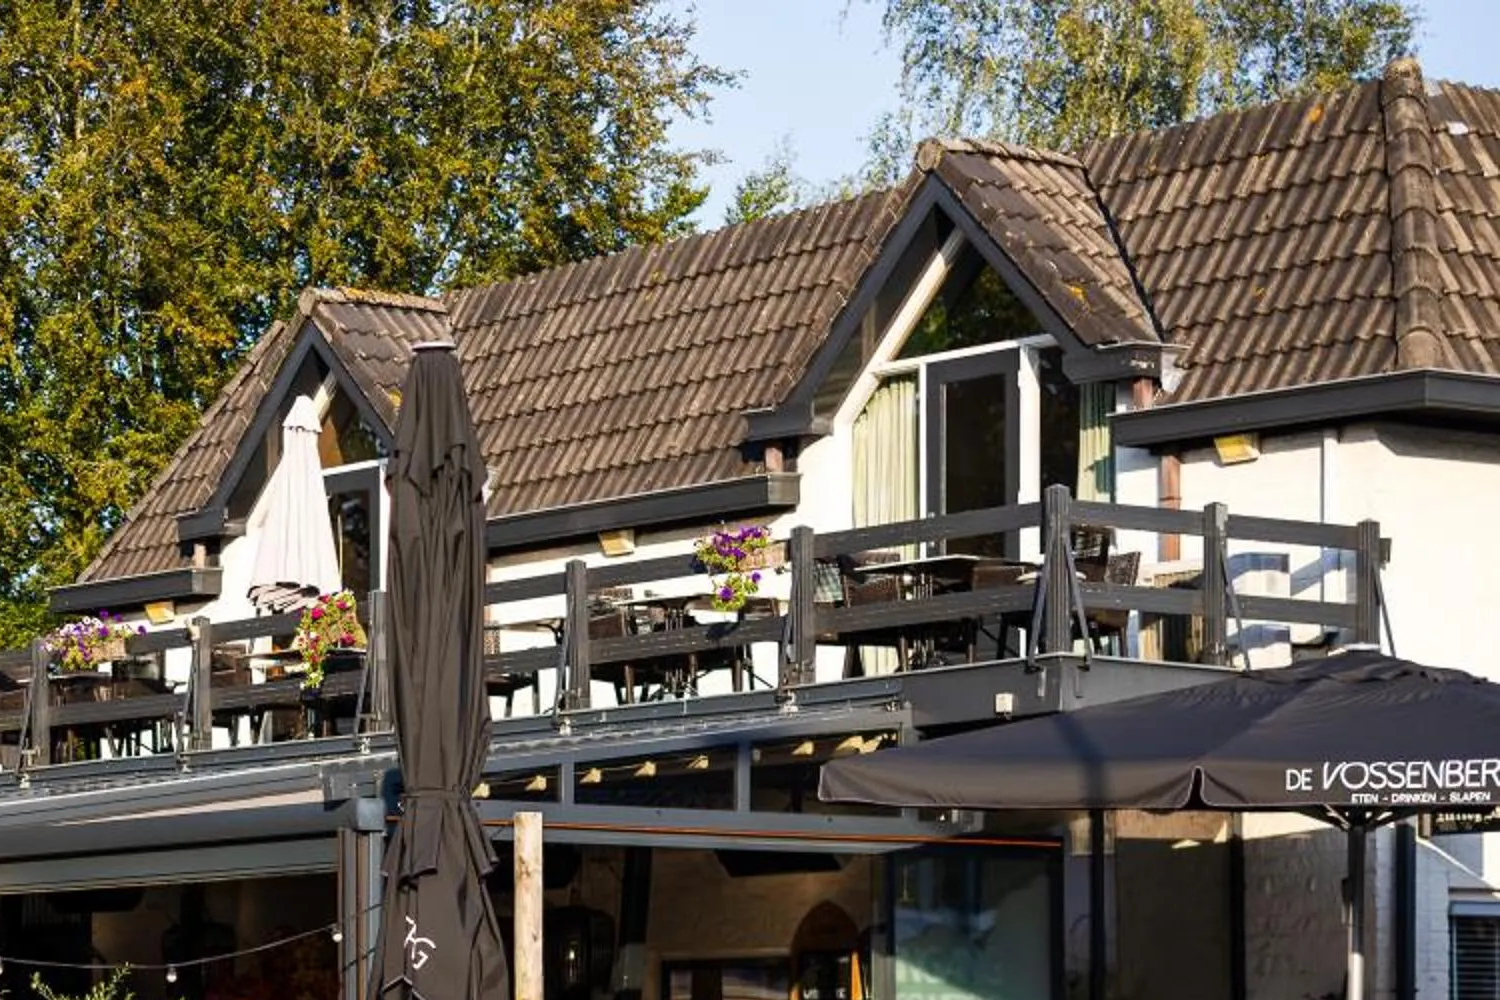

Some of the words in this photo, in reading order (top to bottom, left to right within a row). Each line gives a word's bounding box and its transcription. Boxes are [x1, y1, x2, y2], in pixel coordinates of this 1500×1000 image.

[1285, 768, 1313, 791] DE
[1351, 793, 1379, 804] ETEN
[1391, 793, 1437, 804] DRINKEN
[1449, 791, 1491, 803] SLAPEN
